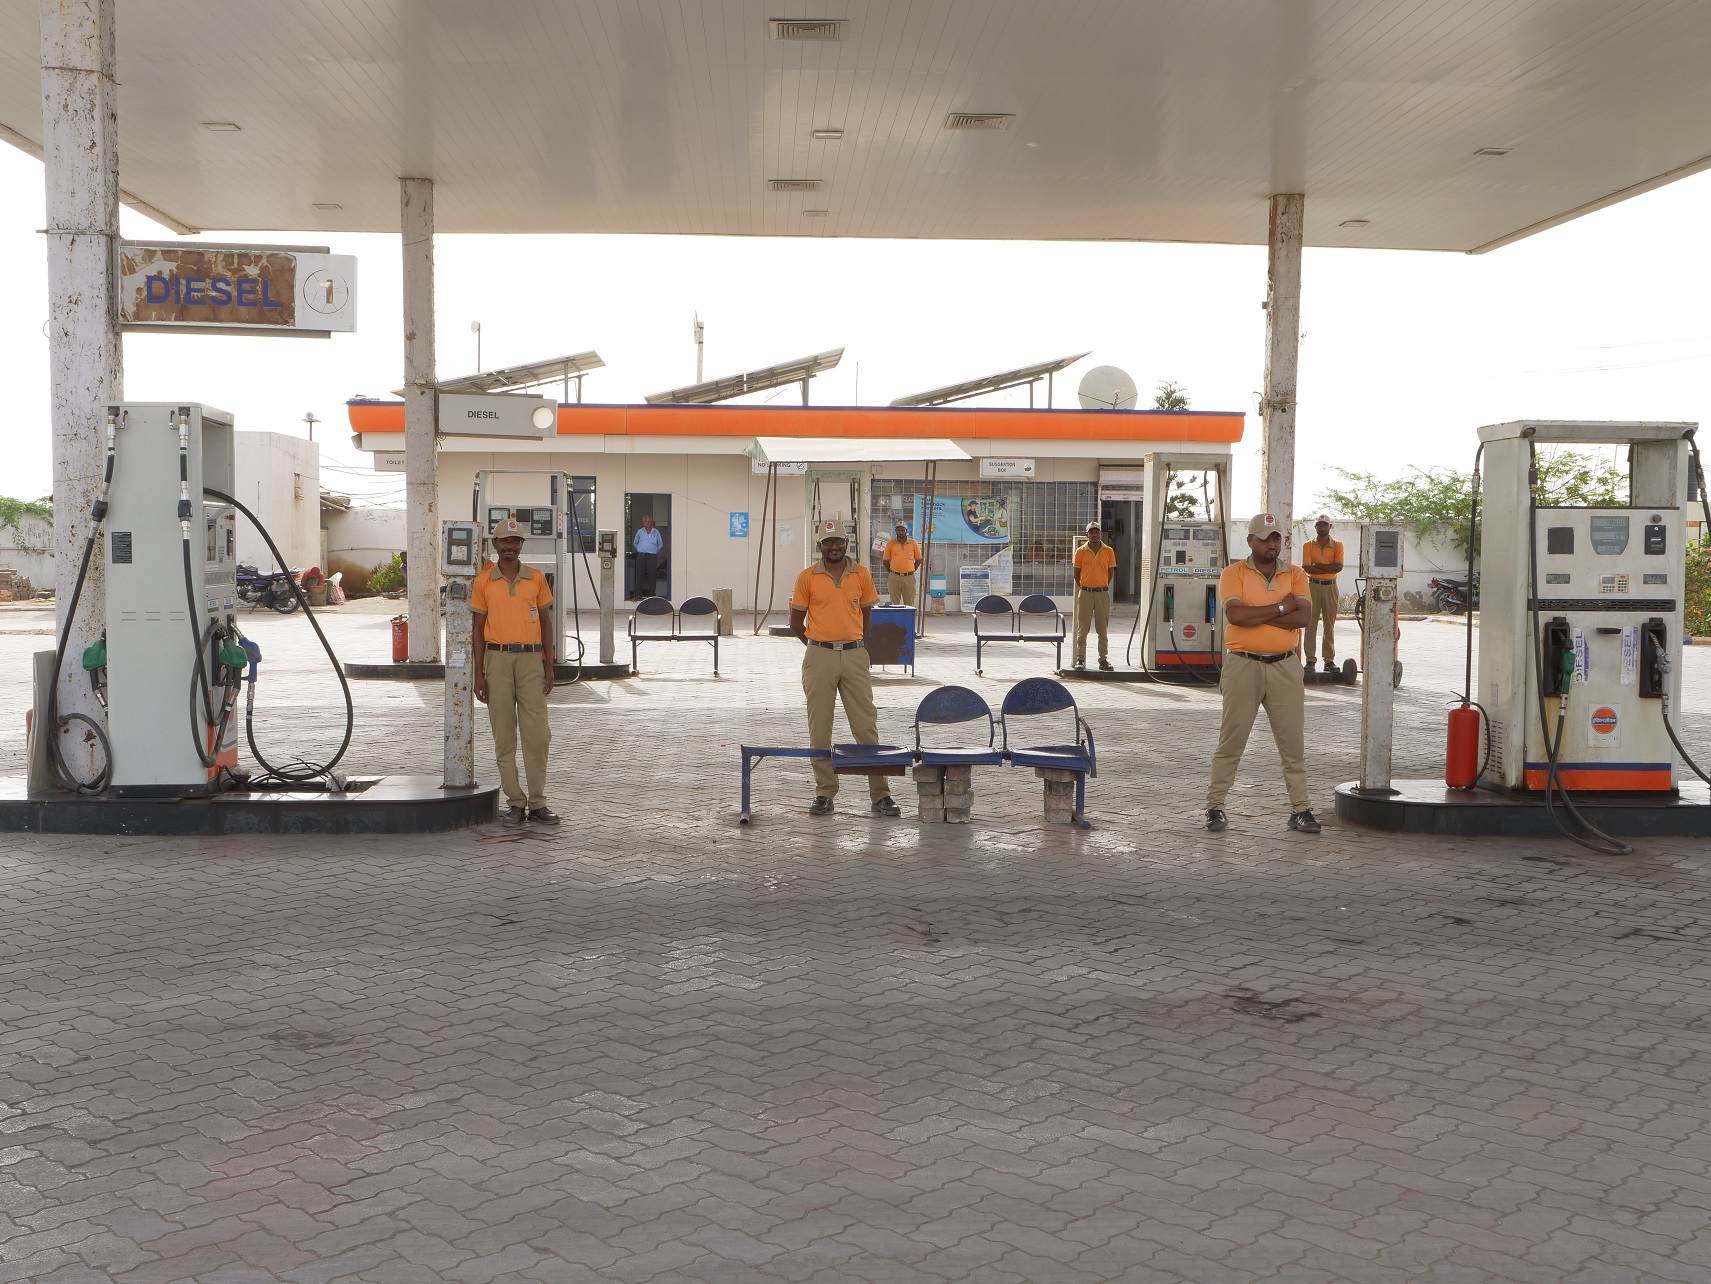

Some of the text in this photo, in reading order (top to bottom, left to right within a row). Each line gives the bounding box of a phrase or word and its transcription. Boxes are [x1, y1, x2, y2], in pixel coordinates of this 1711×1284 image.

[146, 275, 334, 309] DIESEL 1
[467, 410, 500, 420] DIESEL
